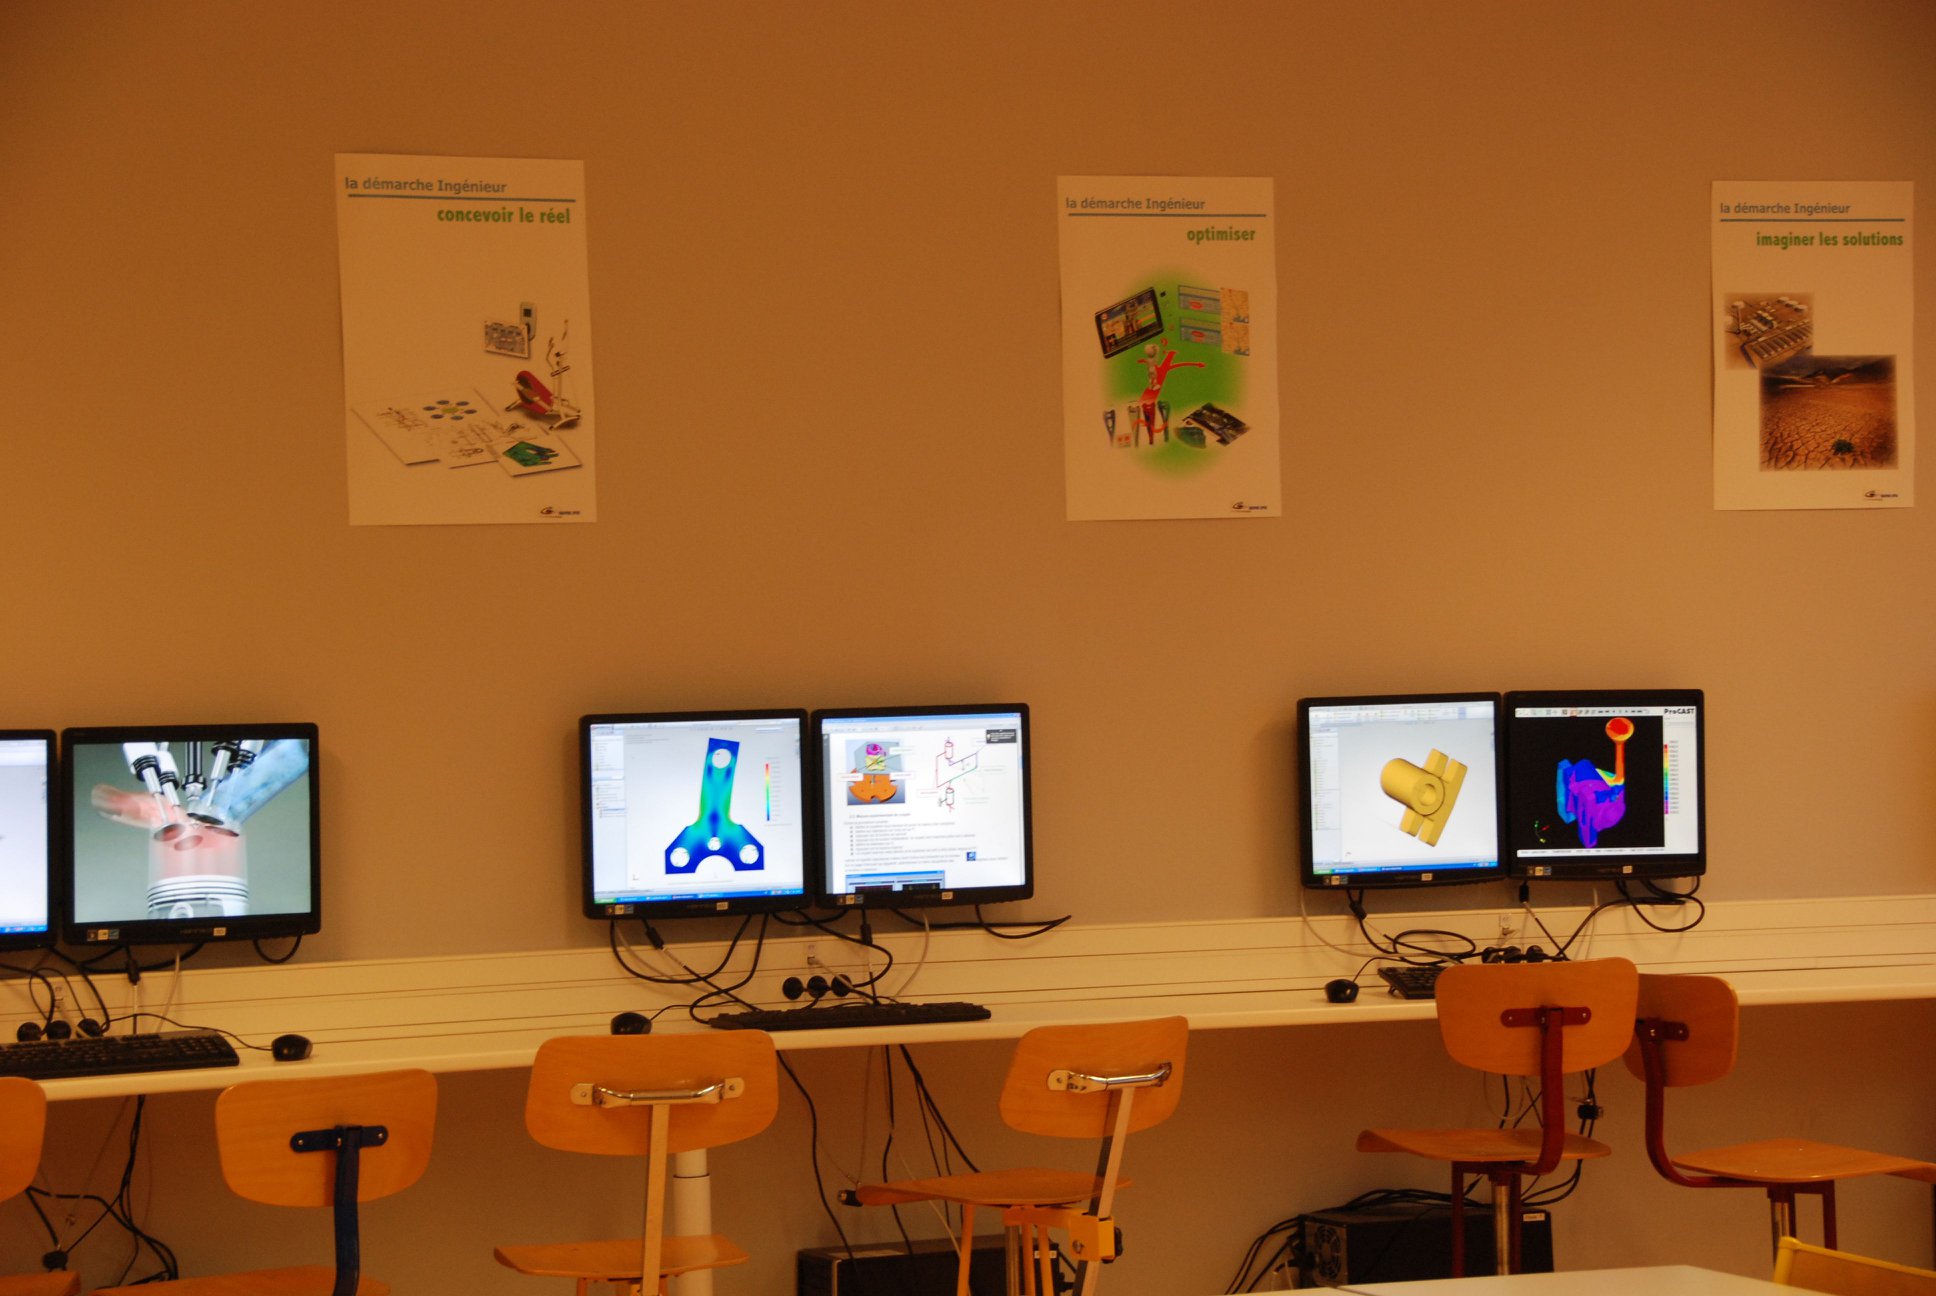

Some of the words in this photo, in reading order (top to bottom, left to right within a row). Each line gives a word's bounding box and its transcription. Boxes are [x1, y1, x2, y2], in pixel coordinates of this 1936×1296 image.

[345, 177, 358, 188] la
[363, 177, 433, 191] démarche
[438, 180, 507, 194] Ingénieur
[1066, 198, 1077, 208] la
[1081, 197, 1142, 209] démarche
[1146, 198, 1205, 212] Ingénieur
[1720, 203, 1731, 214] la
[1734, 202, 1791, 214] démarche
[1794, 202, 1851, 216] Ingénieur
[437, 207, 514, 223] concevoir
[519, 207, 534, 223] le
[540, 208, 571, 224] réel
[1187, 226, 1256, 244] optimiser
[1756, 231, 1815, 250] imaginer
[1819, 231, 1838, 246] les
[1843, 231, 1904, 246] solutions
